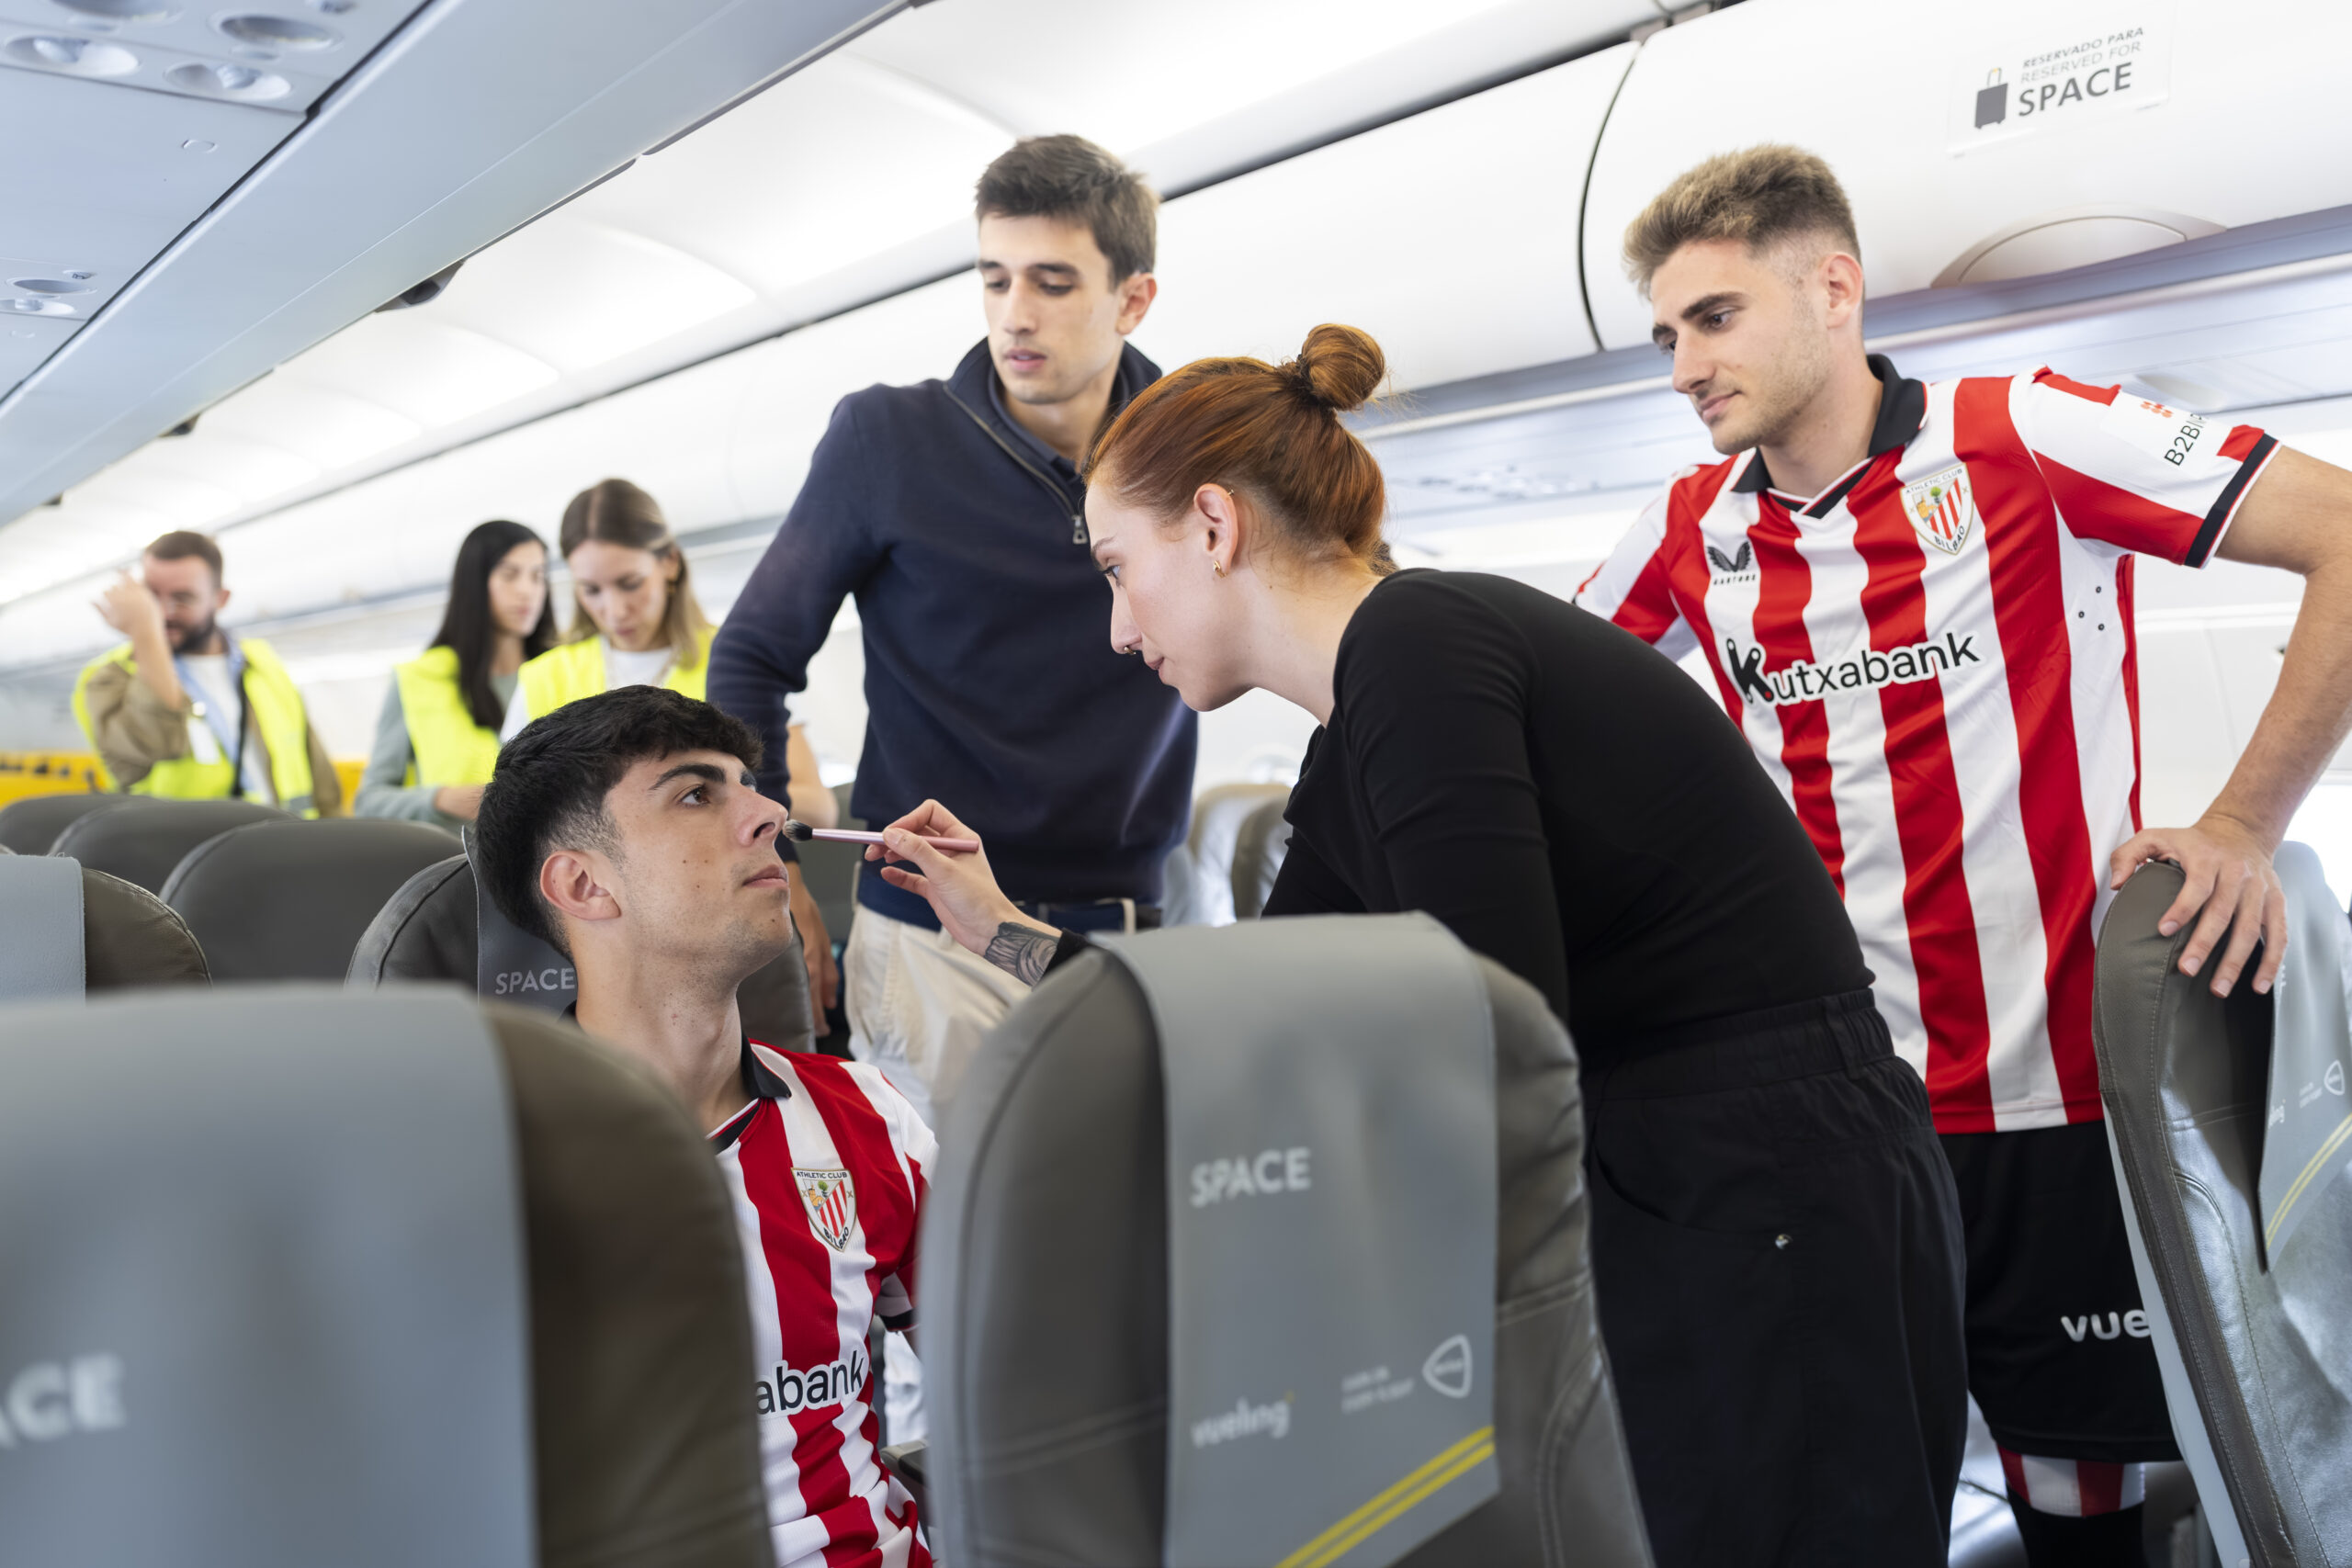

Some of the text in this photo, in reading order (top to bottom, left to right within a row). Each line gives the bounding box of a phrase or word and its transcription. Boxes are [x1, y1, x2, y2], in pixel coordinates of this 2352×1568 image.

[2021, 41, 2142, 83] RESERVED FOR
[2023, 28, 2143, 68] RESERVADO PARA
[2018, 62, 2132, 117] SPACE
[1905, 468, 1962, 494] ATHLETIC CLUB
[1934, 525, 1965, 552] BILBAO
[1726, 632, 1981, 704] Kutxabank
[494, 967, 575, 995] SPACE
[797, 1171, 847, 1179] ATHLETIC CLUB
[1190, 1146, 1312, 1209] SPACE
[823, 1226, 850, 1250] BILBAO
[2060, 1309, 2151, 1342] vue
[0, 1351, 127, 1451] CE
[755, 1349, 865, 1415] abank
[1191, 1394, 1290, 1449] vueling
